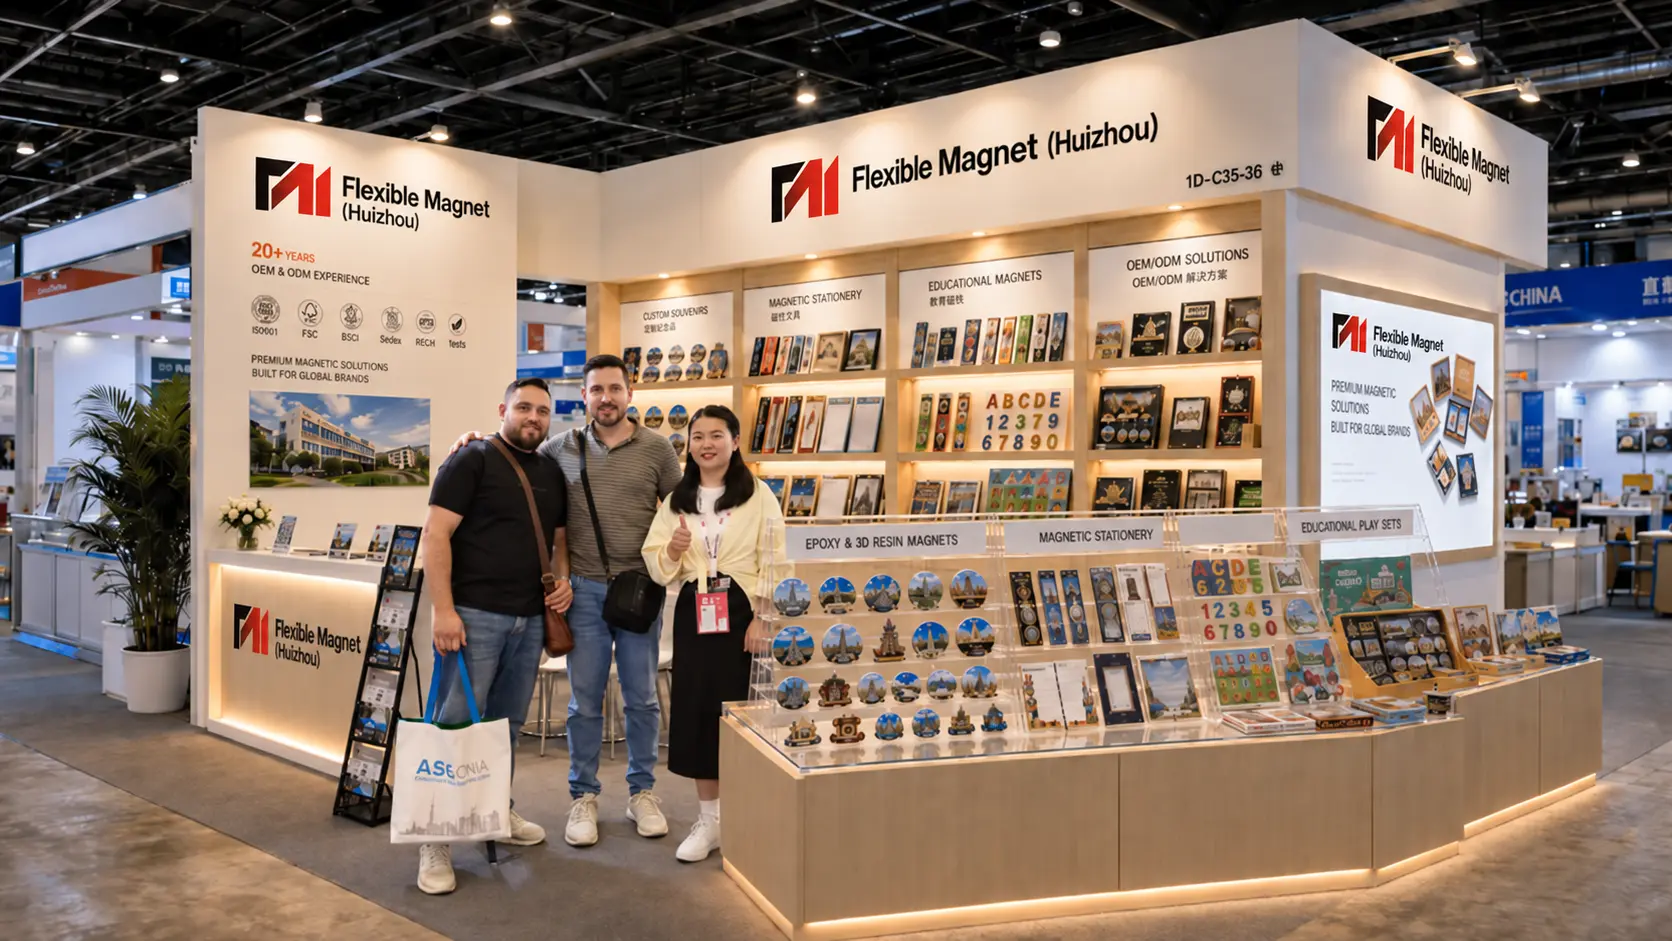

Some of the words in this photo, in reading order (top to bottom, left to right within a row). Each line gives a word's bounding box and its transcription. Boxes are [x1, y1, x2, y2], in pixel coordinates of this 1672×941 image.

[852, 154, 932, 192] Flexible
[938, 133, 1038, 177] Magnet
[1048, 112, 1159, 160] (Huizhou)
[1422, 123, 1469, 166] Flexible
[1472, 148, 1510, 184] Magnet
[1186, 164, 1262, 188] 1D-C35-36
[1422, 155, 1472, 196] (Huizhou)
[342, 176, 418, 208] Flexible
[424, 188, 490, 219] Magnet
[342, 203, 420, 231] (Huizhou)
[252, 242, 283, 259] 20+
[285, 250, 315, 263] YEARS
[1126, 255, 1180, 271] OEM/ODM
[1185, 248, 1249, 265] SOLUTIONS
[252, 264, 275, 276] OEM
[278, 267, 284, 276] &
[287, 268, 311, 279] ODM
[314, 270, 370, 286] EXPERIENCE
[928, 276, 992, 292] EDUCATIONAL
[995, 270, 1042, 284] MAGNETS
[1132, 274, 1182, 288] OEM/ODM
[769, 295, 810, 308] MAGNETIC
[812, 290, 862, 304] STATIONERY
[643, 310, 669, 320] CUSTOM
[302, 329, 318, 338] FSC
[342, 332, 359, 342] BSCI
[380, 334, 402, 344] Sedex
[416, 338, 435, 347] RECH
[1374, 326, 1409, 346] Flexible
[1411, 333, 1444, 353] Magnet
[1373, 344, 1411, 362] (Huizhou)
[251, 354, 292, 366] PREMIUM
[295, 358, 338, 369] MAGNETIC
[340, 360, 388, 372] SOLUTIONS
[252, 368, 276, 379] BUILT
[279, 370, 296, 380] FOR
[299, 370, 332, 382] GLOBAL
[334, 372, 370, 384] BRANDS
[1332, 379, 1363, 395] PREMIUM
[1364, 385, 1396, 398] MAGNETIC
[1332, 400, 1369, 414] SOLUTIONS
[1332, 421, 1349, 433] BUILT
[1350, 424, 1362, 434] FOR
[1364, 424, 1386, 436] GLOBAL
[1388, 426, 1410, 437] BRANDS
[1302, 520, 1357, 534] EDUCATIONAL
[1359, 520, 1380, 531] PLAY
[1382, 518, 1401, 530] SETS
[806, 538, 840, 550] EPOXY
[844, 537, 852, 549] &
[856, 536, 870, 549] 3D
[873, 536, 903, 548] RESIN
[907, 534, 958, 548] MAGNETS
[1039, 531, 1092, 543] MAGNETIC
[1094, 528, 1154, 542] STATIONERY
[276, 618, 314, 644] Flexible
[318, 626, 361, 654] Magnet
[275, 643, 320, 670] (Huizhou)
